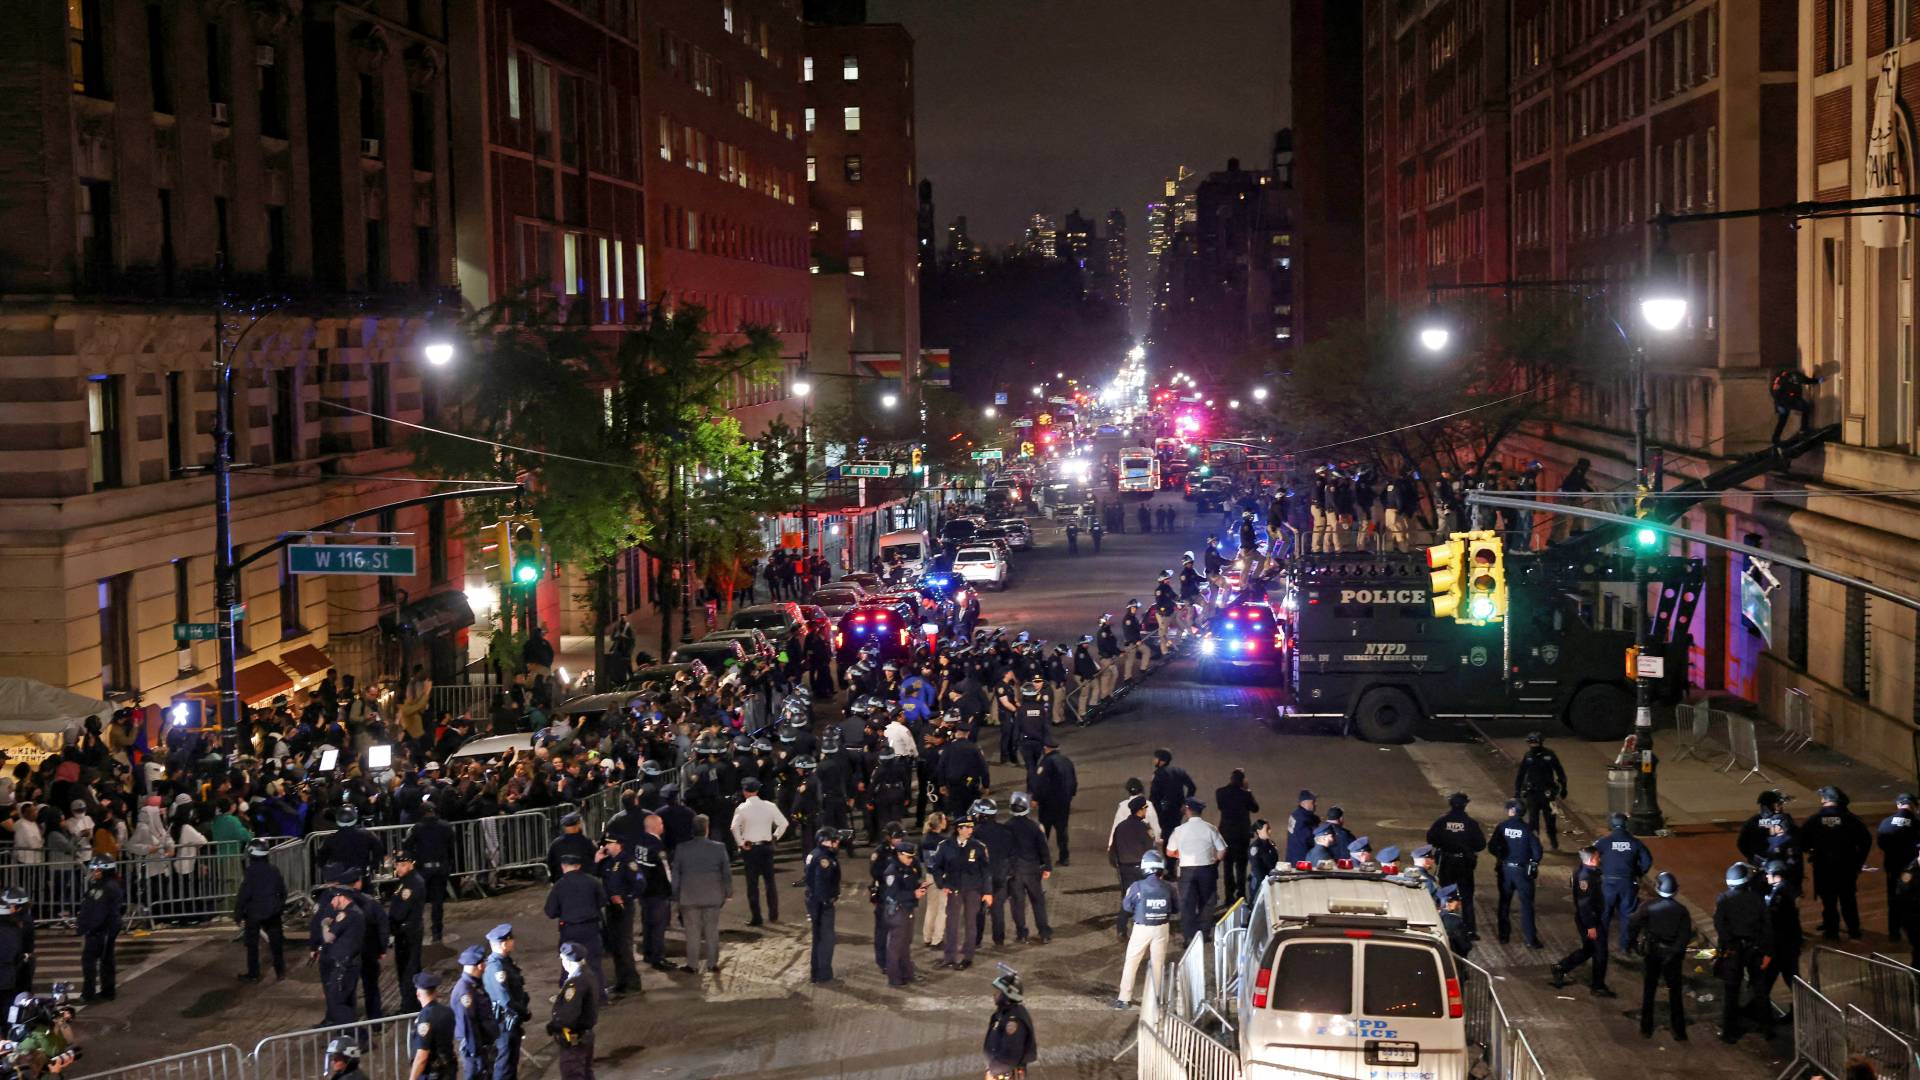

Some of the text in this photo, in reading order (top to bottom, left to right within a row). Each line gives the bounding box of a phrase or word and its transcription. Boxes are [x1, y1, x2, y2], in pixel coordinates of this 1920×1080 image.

[315, 551, 390, 569] W 116 St
[1340, 589, 1426, 604] POLICE
[1364, 643, 1407, 655] NYPD
[1446, 822, 1465, 831] NYPD
[1504, 828, 1523, 837] NYPD
[1611, 841, 1631, 850] NYPD
[1146, 898, 1167, 907] NYPD
[1316, 1026, 1398, 1039] PLICE
